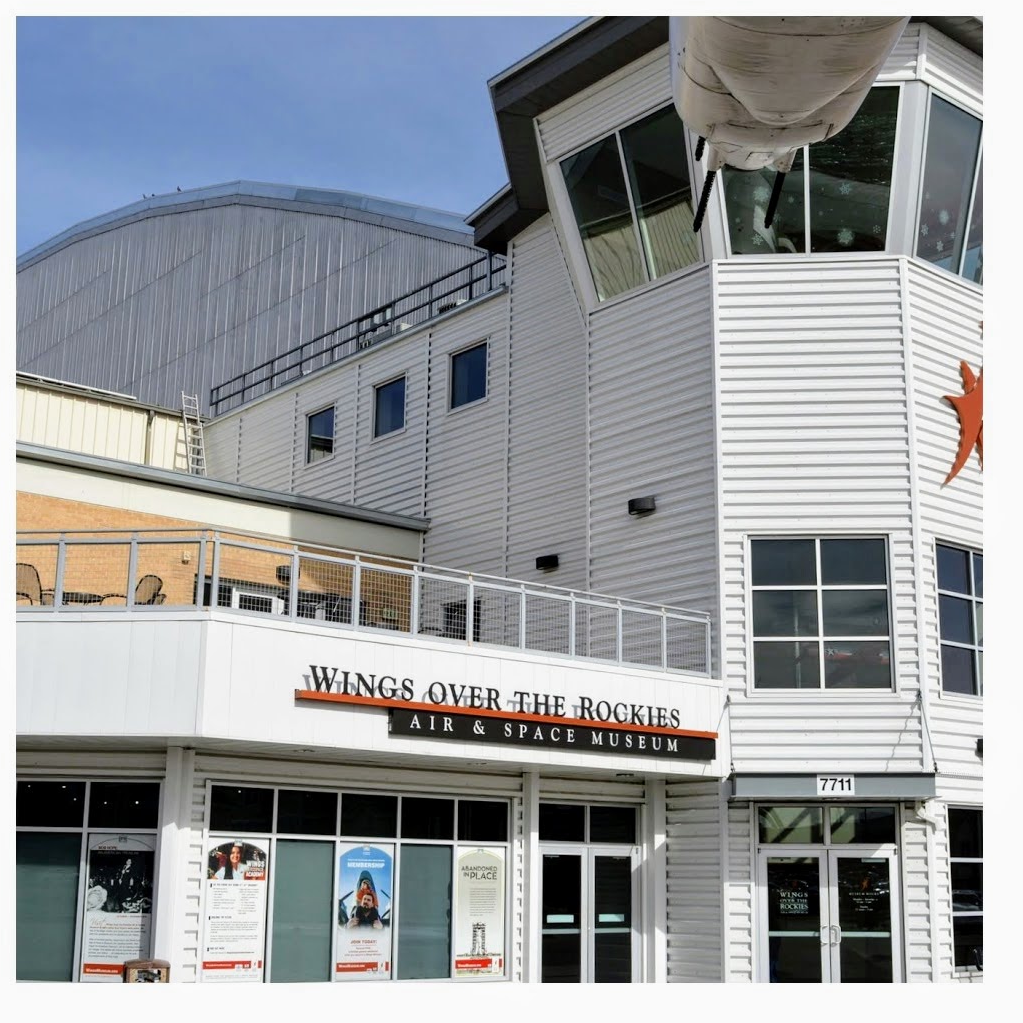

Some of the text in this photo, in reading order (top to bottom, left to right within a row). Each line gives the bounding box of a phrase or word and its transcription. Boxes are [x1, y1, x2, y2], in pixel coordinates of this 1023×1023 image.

[309, 664, 681, 730] WINGS OVER THE ROCKIES
[409, 713, 679, 753] AIR & SPACE MUSEUM
[820, 778, 852, 791] 7711
[469, 871, 498, 880] PLACE
